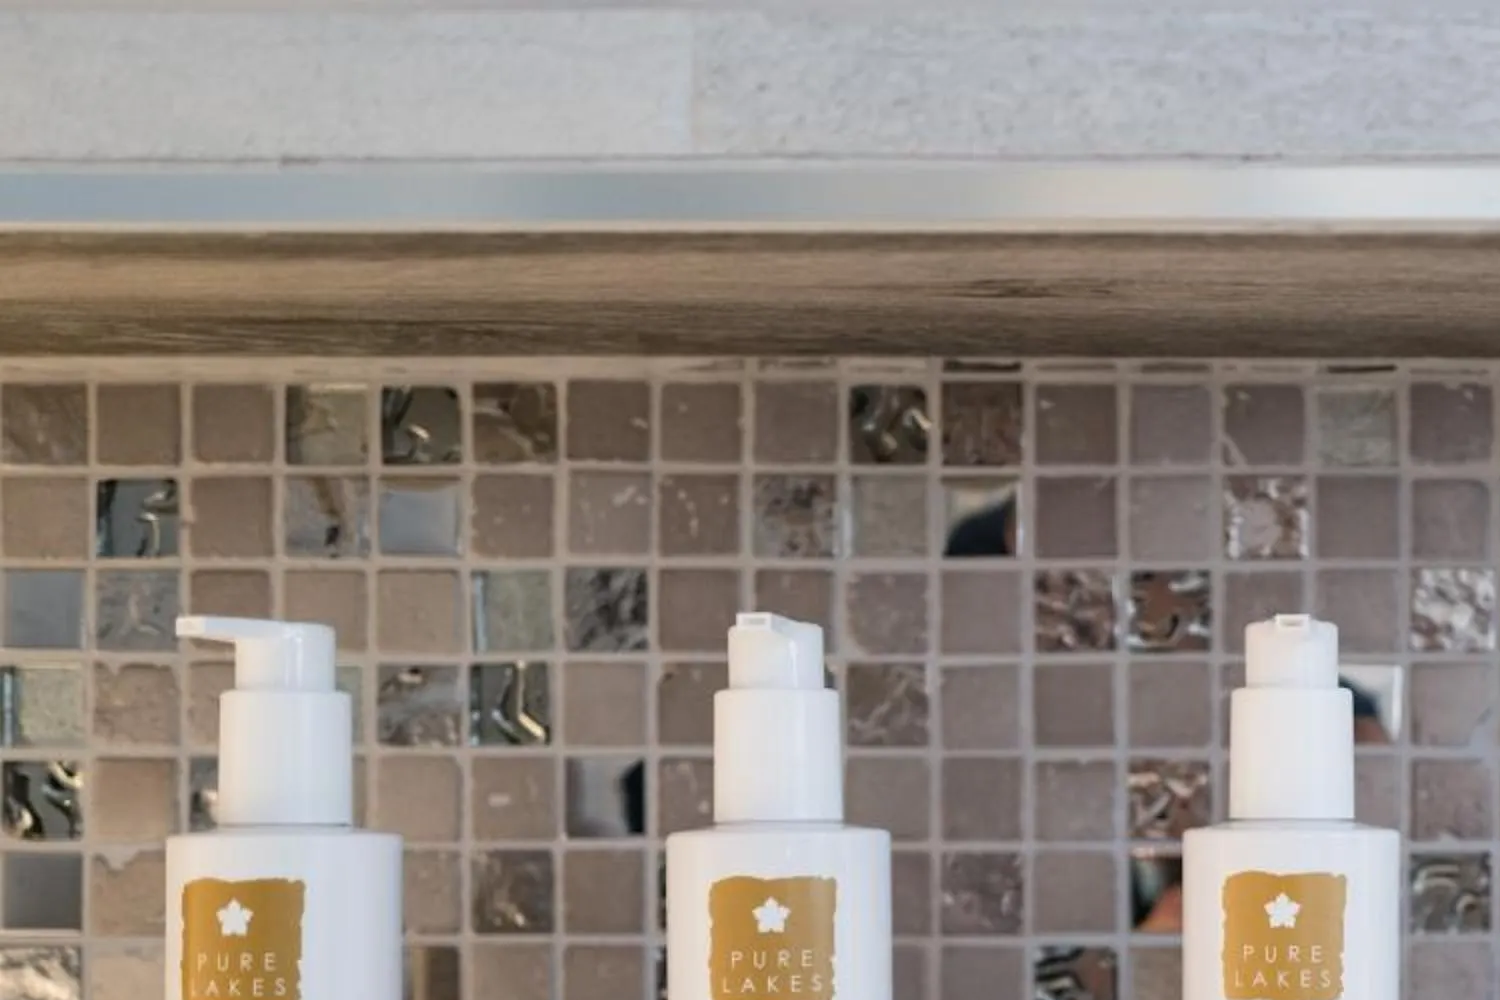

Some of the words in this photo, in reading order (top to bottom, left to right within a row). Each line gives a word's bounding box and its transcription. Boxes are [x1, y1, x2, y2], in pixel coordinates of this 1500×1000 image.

[197, 952, 277, 972] PURE
[731, 950, 813, 969] PURE
[1243, 945, 1322, 964] PURE
[190, 977, 286, 997] LAKES
[722, 975, 823, 993] LAKES
[1234, 971, 1331, 988] LAKES
